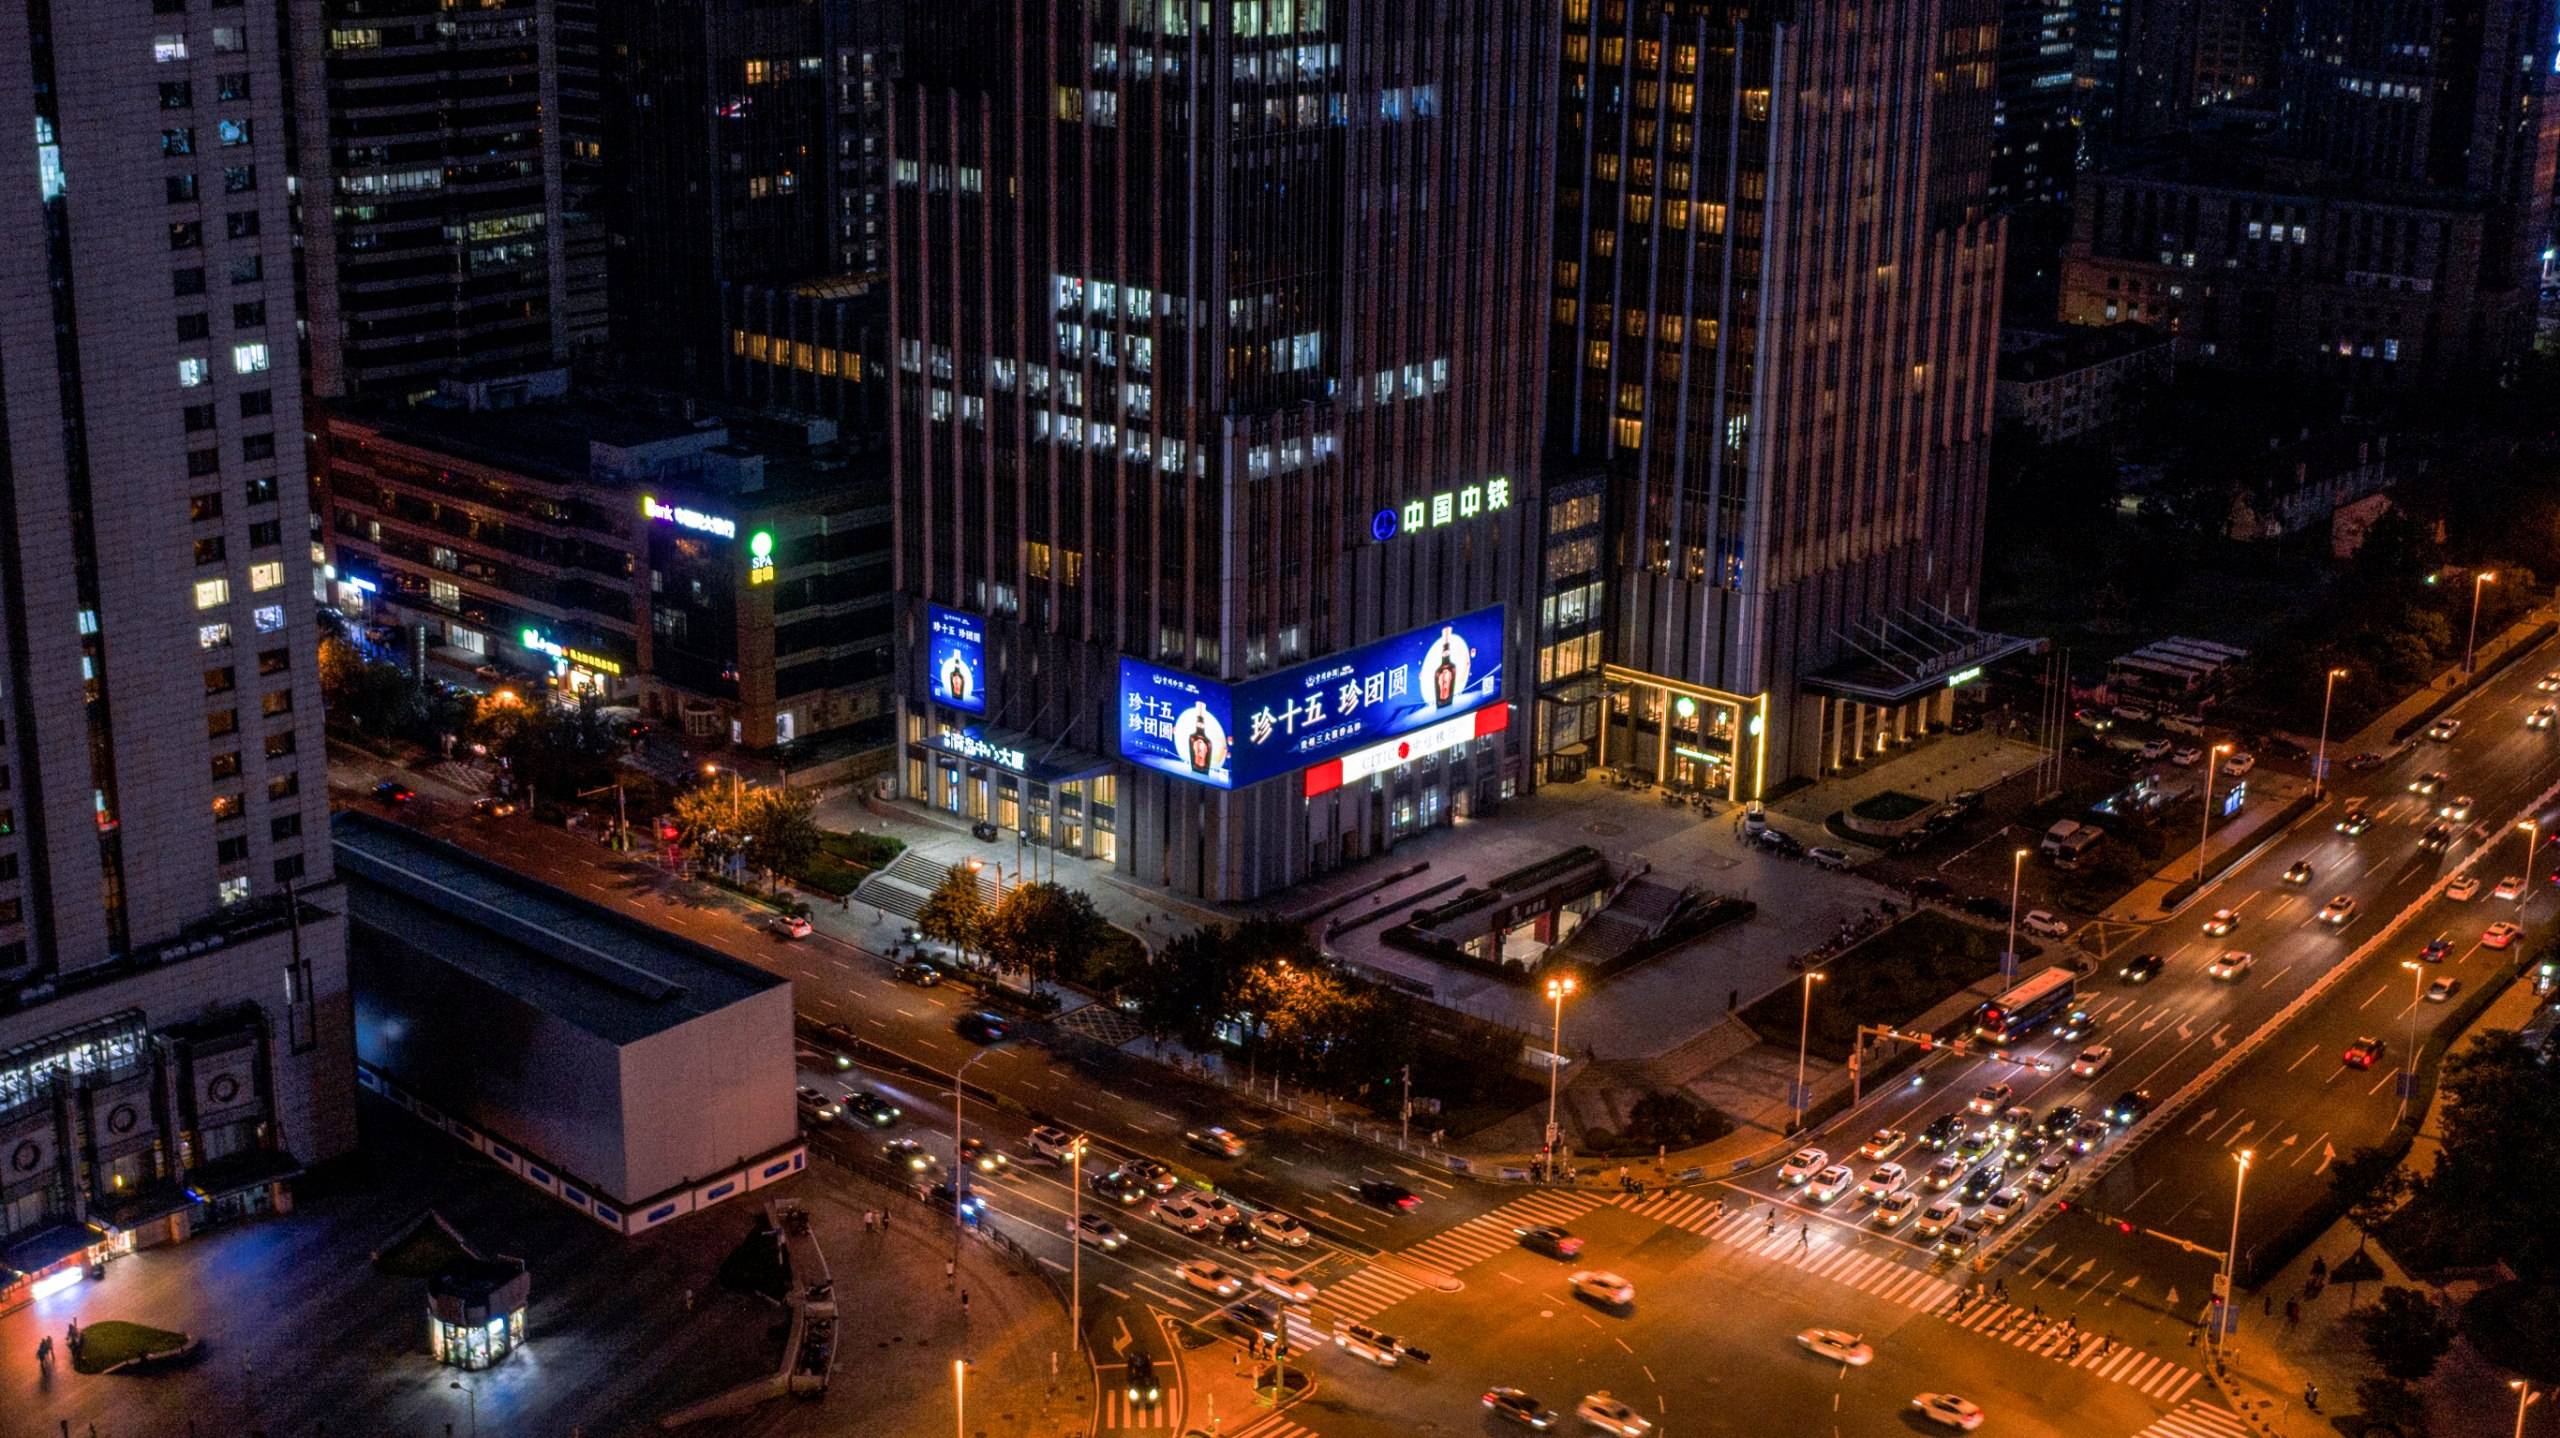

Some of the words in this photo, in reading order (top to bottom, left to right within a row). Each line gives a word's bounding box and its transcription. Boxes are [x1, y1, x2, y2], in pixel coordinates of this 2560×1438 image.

[645, 496, 673, 521] Bank
[1403, 477, 1509, 533] 中国中铁
[752, 555, 773, 569] SPA
[1128, 691, 1175, 721] 珍十五
[1250, 690, 1327, 745] 珍十五
[1337, 663, 1409, 714] 珍团圆
[1128, 712, 1173, 741] 珍团圆
[953, 733, 1025, 771] 青岛中心大厦
[1362, 747, 1395, 770] CITIC
